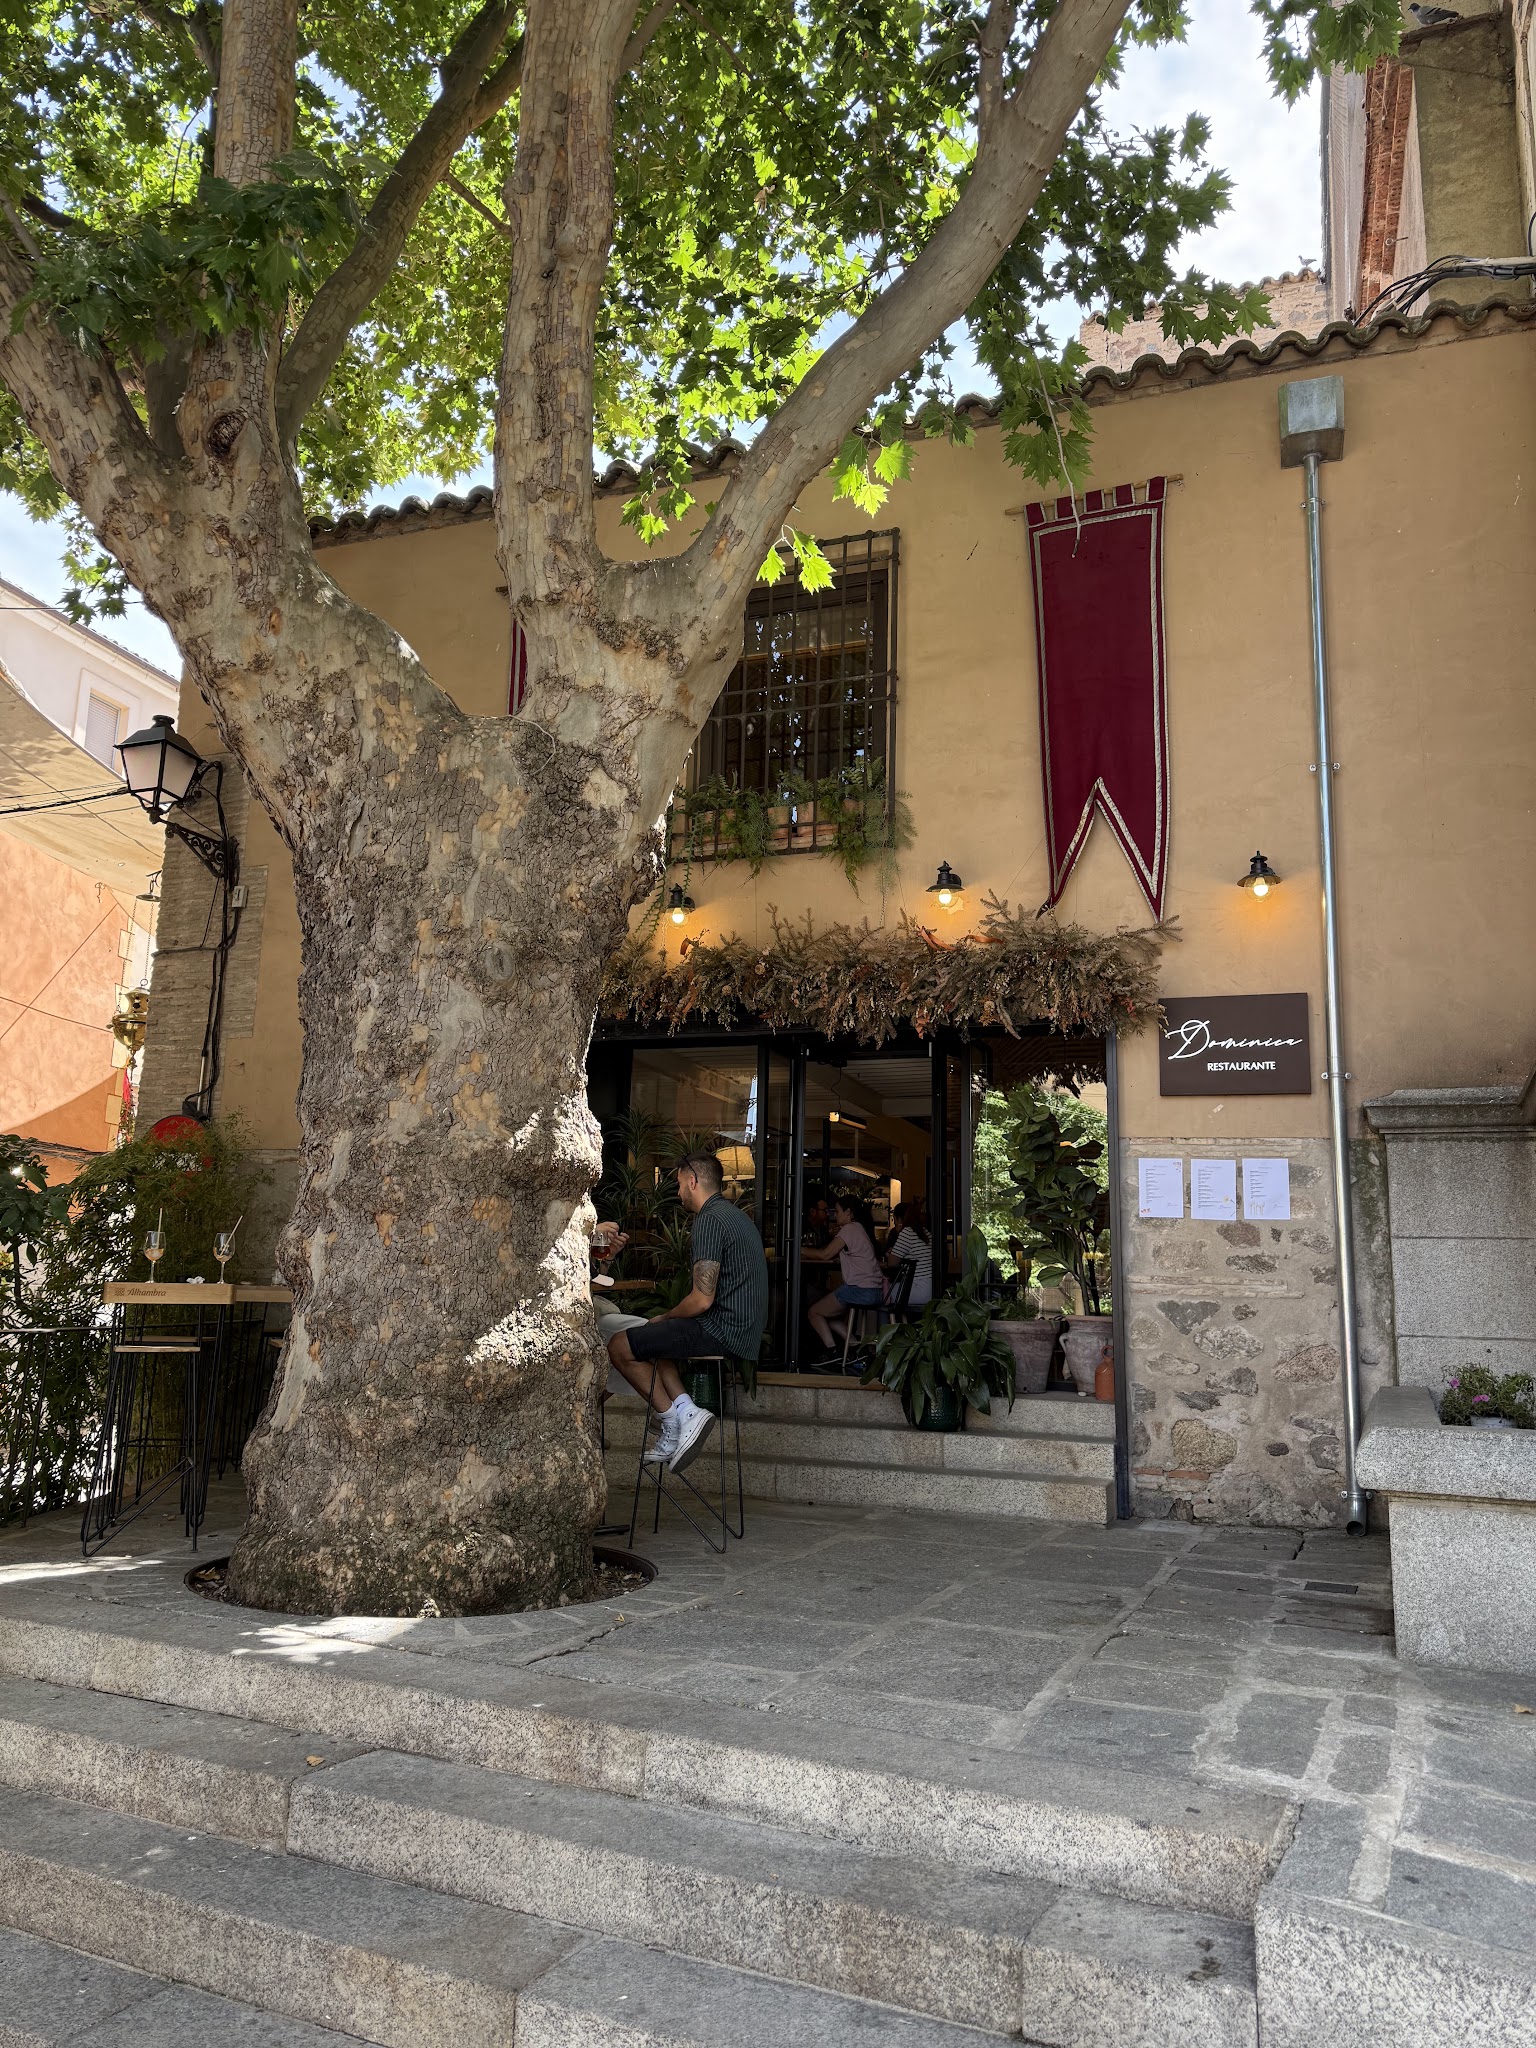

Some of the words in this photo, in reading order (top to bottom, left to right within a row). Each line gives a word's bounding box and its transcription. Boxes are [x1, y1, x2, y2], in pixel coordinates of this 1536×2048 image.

[1165, 1019, 1303, 1060] Dominica
[1207, 1061, 1276, 1071] RESTAURANTE
[127, 1288, 166, 1296] Alhambra
